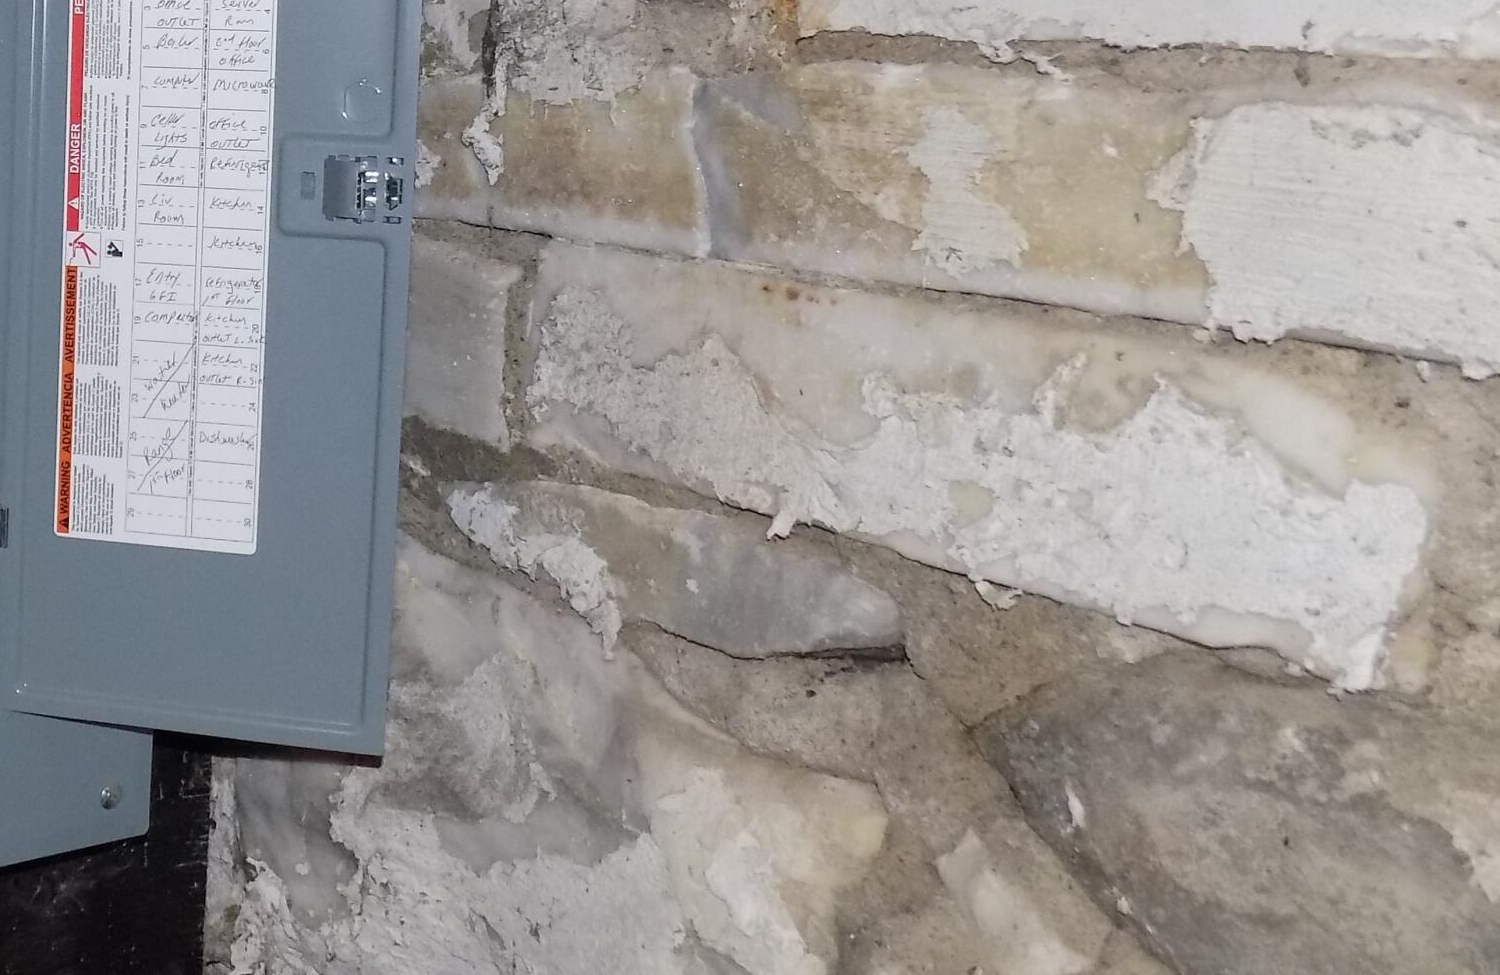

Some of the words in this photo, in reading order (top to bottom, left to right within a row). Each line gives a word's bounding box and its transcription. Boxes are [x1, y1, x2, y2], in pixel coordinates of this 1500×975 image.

[69, 124, 81, 175] DANGER
[65, 267, 77, 363] AVERTISSEMENT
[62, 366, 75, 454] ADVERTENCIA
[59, 461, 71, 515] WARNING
